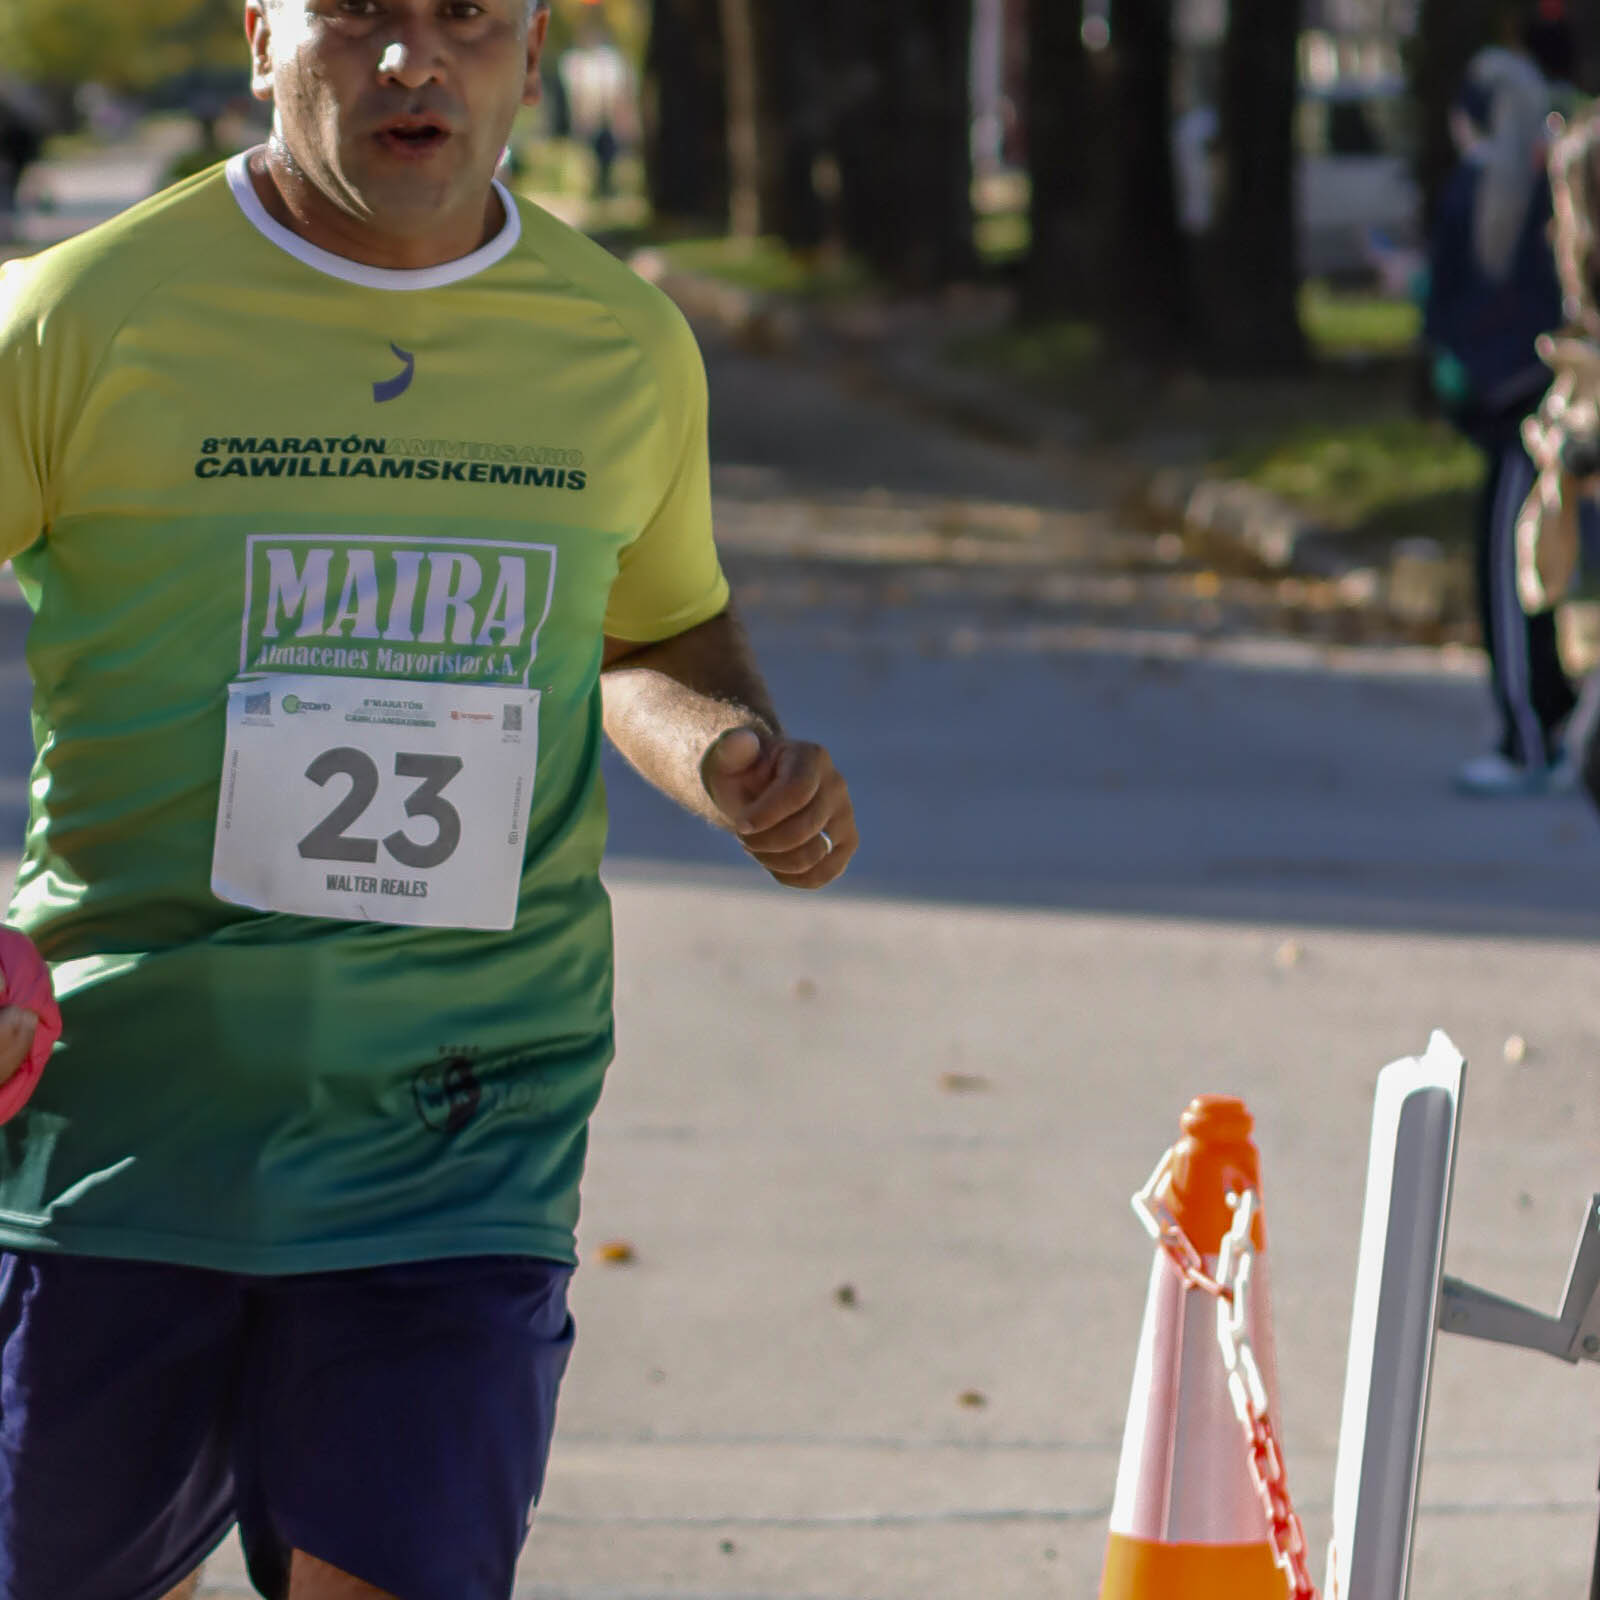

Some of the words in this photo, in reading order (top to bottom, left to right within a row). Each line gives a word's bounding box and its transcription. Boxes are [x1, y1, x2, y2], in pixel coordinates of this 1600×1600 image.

[194, 456, 588, 491] CAWILLIAMSKEMMIS
[261, 548, 527, 647] MAIRA
[297, 746, 464, 869] 23
[326, 873, 378, 895] WALTER
[380, 877, 429, 899] REALES
